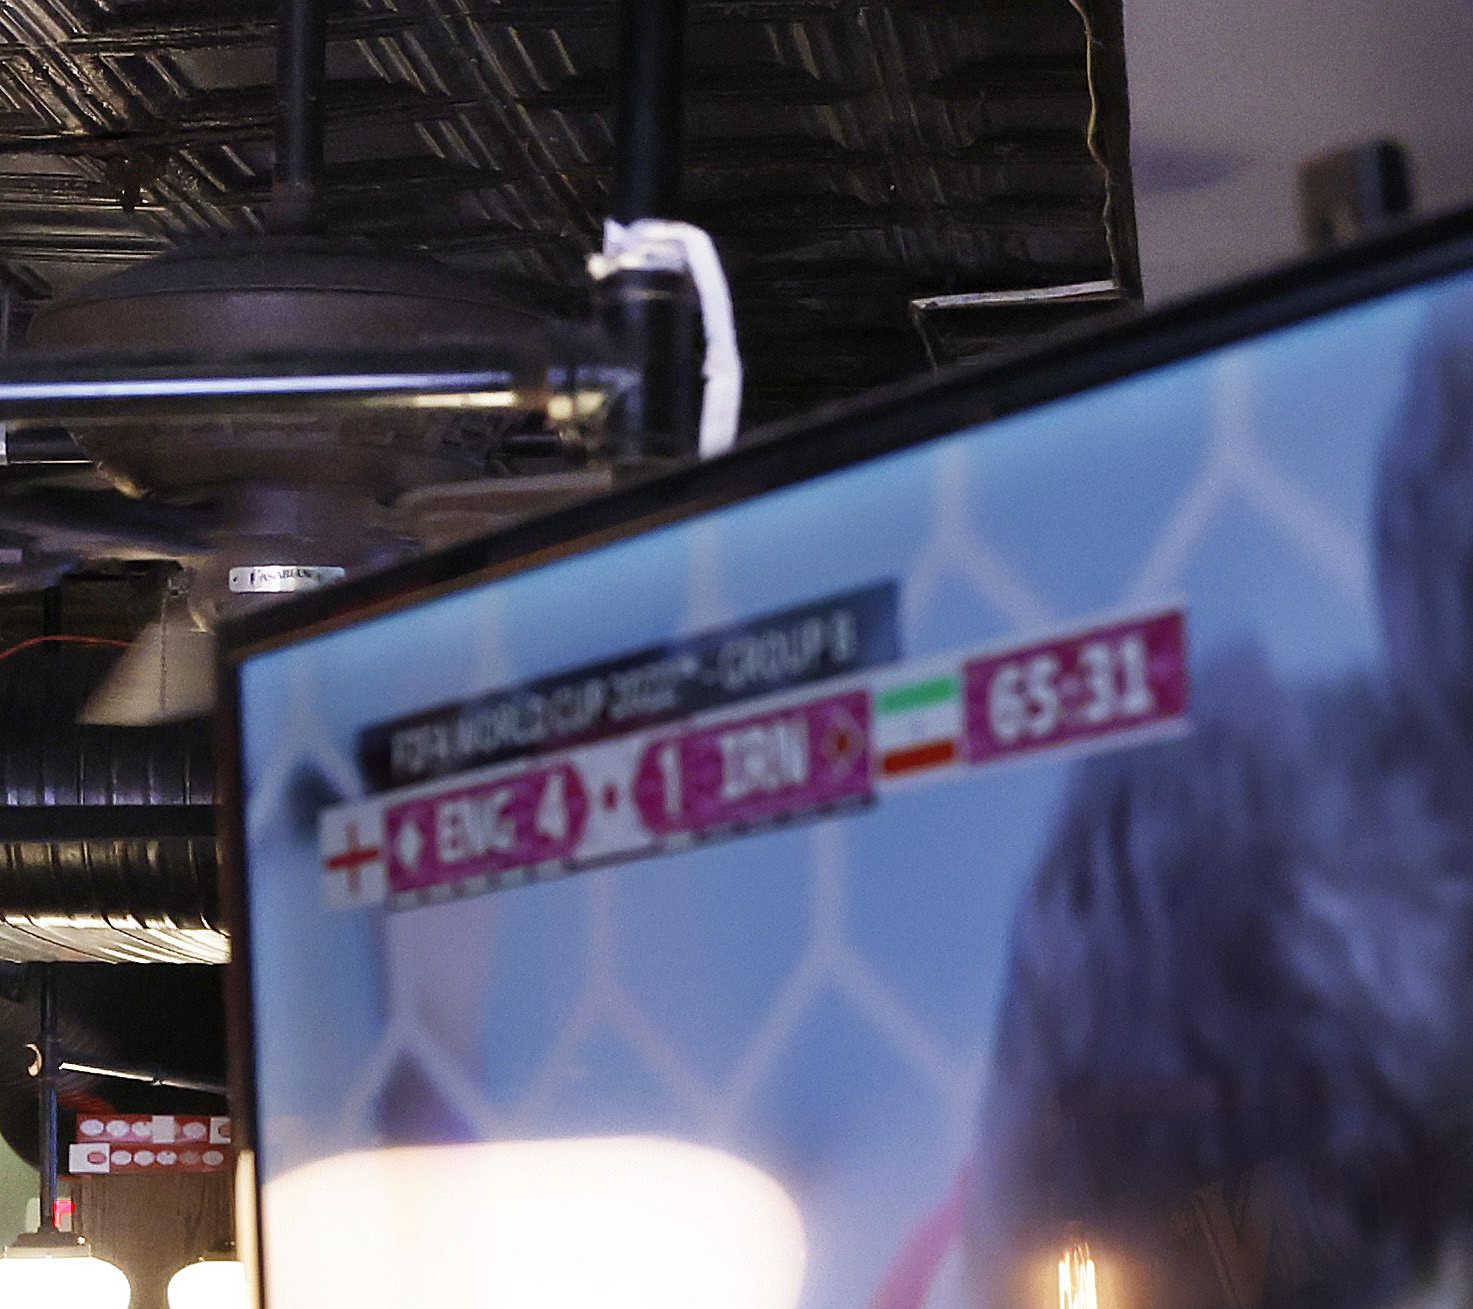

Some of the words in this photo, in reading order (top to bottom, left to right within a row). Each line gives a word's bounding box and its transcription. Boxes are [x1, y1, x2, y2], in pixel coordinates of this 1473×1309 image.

[987, 635, 1152, 746] 65:31
[535, 769, 569, 842] 4
[658, 744, 686, 818] 1
